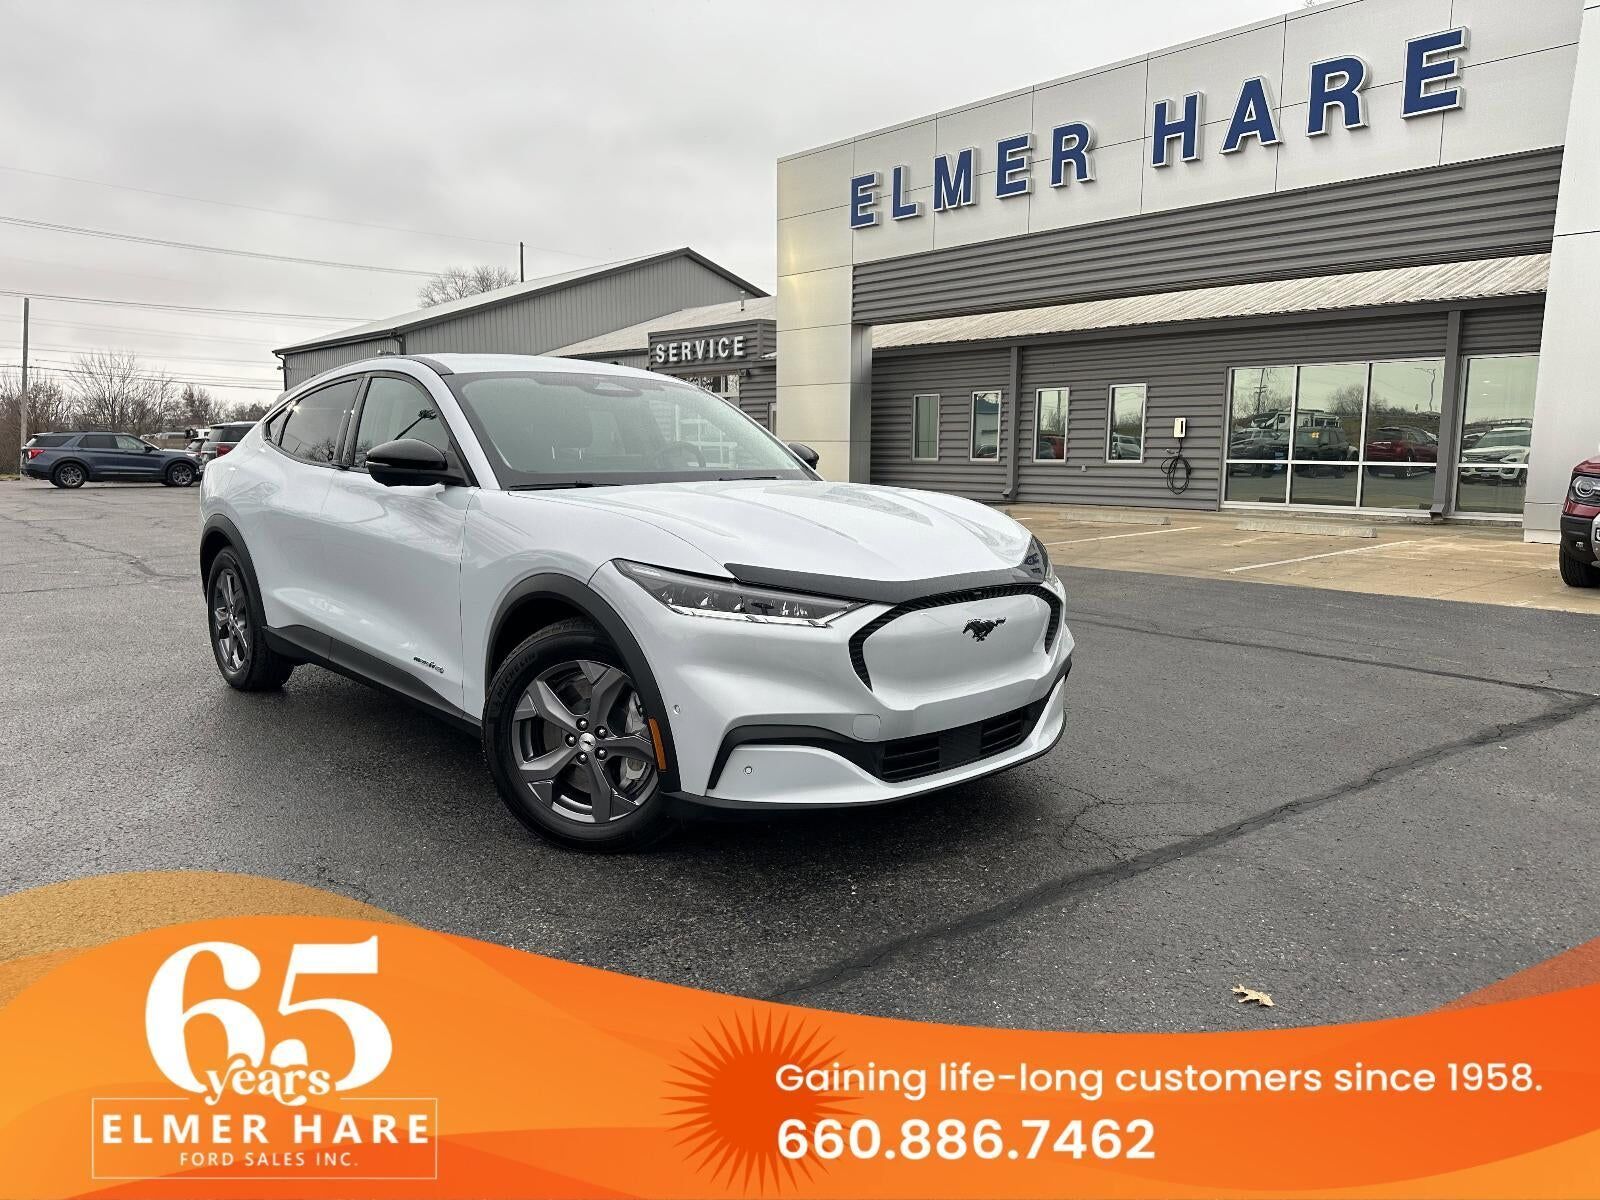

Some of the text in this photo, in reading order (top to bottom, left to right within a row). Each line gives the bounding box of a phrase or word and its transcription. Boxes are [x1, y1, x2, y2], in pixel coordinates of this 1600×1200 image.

[850, 26, 1469, 229] ELMER HARE
[655, 334, 746, 364] SERVICE
